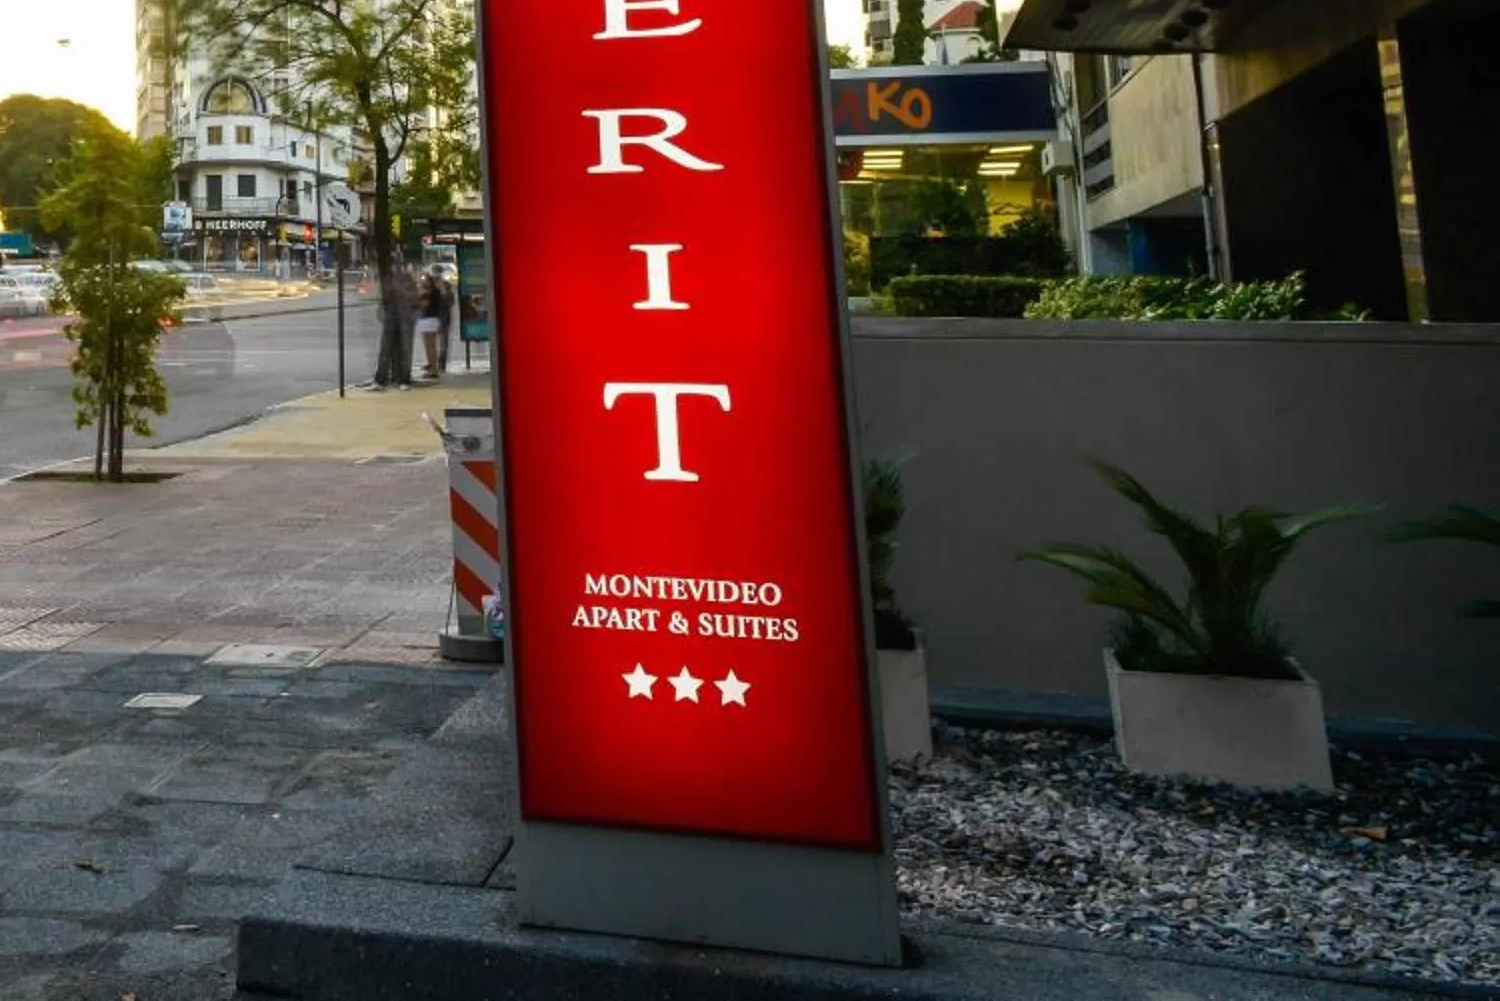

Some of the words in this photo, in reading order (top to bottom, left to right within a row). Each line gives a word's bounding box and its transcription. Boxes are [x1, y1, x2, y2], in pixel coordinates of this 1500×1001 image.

[584, 573, 783, 607] MONTEVIDEO
[571, 605, 661, 633] APART
[667, 611, 690, 636] &
[697, 612, 800, 642] SUITES
